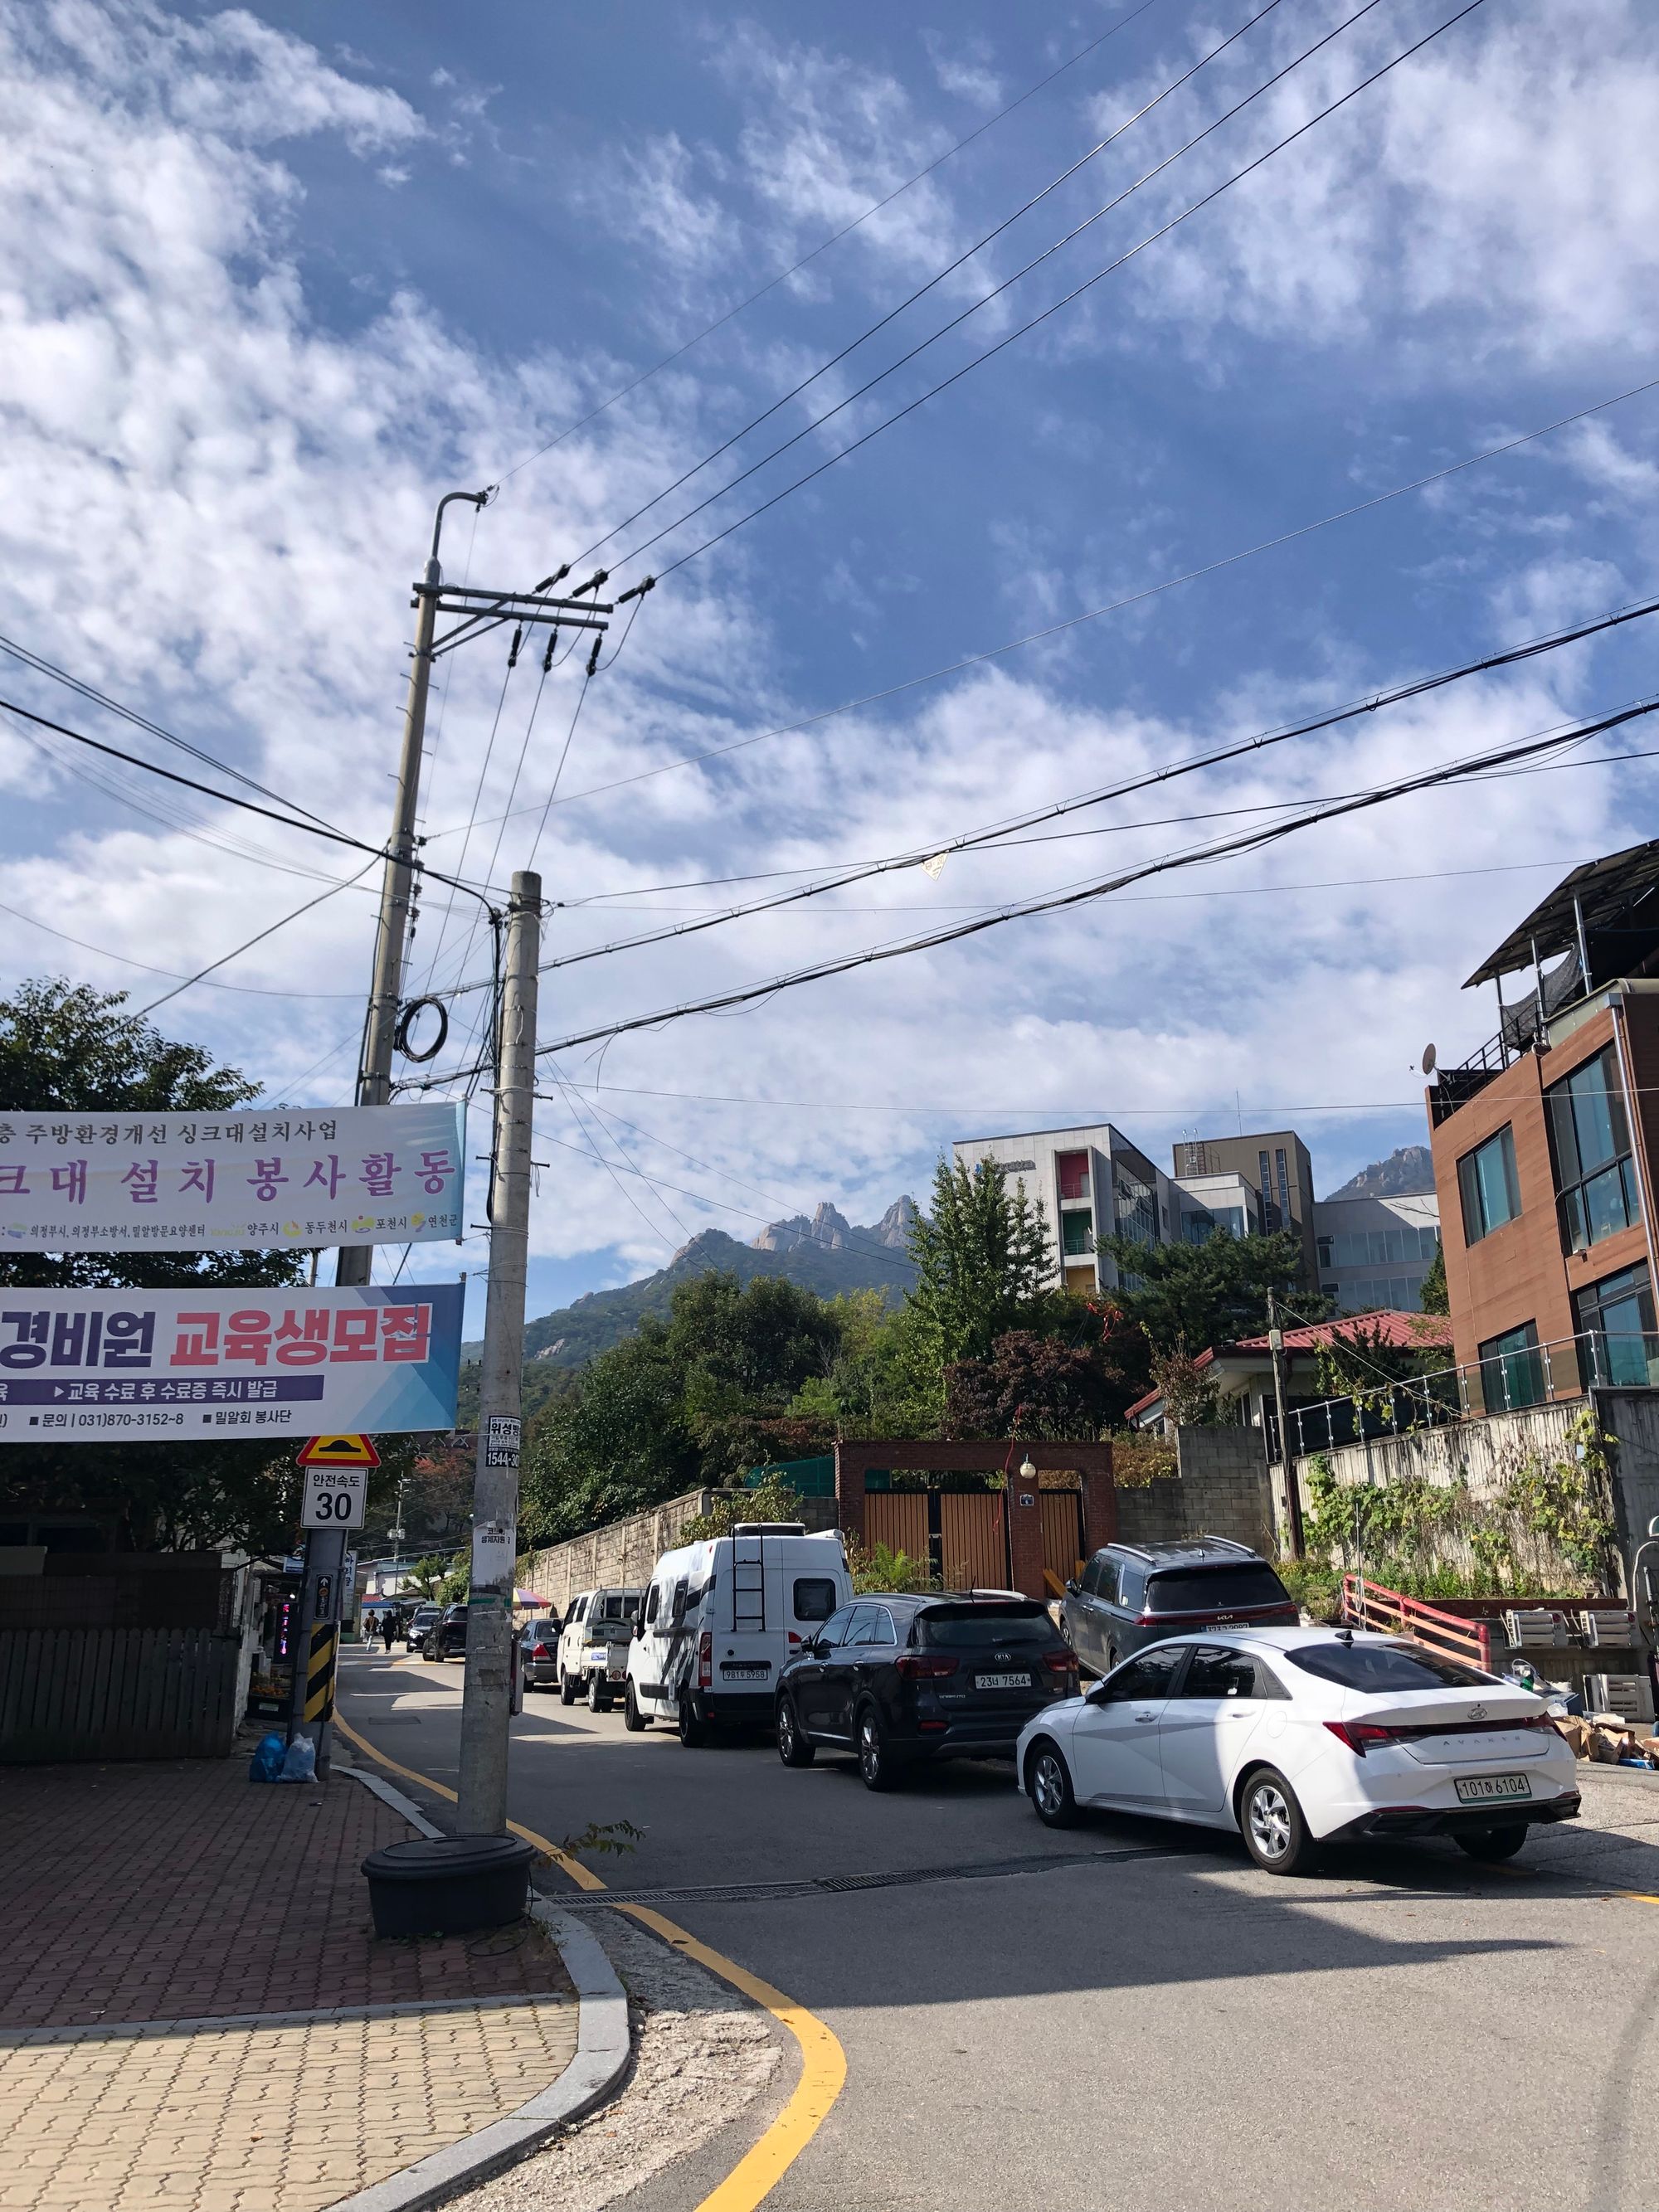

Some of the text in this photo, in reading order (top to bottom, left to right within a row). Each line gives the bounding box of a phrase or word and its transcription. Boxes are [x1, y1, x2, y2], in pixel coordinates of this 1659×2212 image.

[26, 1124, 167, 1145] 주방환경개선
[178, 1120, 337, 1144] 싱크대설치사업
[121, 1158, 215, 1204] 설치
[246, 1150, 455, 1203] 봉사활동
[247, 1222, 279, 1236] 양주시
[304, 1219, 348, 1234] 동두천시
[375, 1216, 406, 1230] 포천시
[428, 1213, 457, 1229] 연천군
[0, 1305, 429, 1369] 경비원 교육생모집
[68, 1383, 100, 1400] 교육
[105, 1383, 135, 1400] 수료
[140, 1382, 156, 1400] 후
[160, 1382, 207, 1400] 수료증
[212, 1381, 242, 1399] 즉시
[247, 1380, 278, 1398] 발급
[42, 1409, 292, 1427] 문의 031)870-3152~8 밀알회 봉사단
[313, 1474, 360, 1488] 안전속도
[315, 1492, 352, 1521] 30
[1002, 1675, 1027, 1686] 7564
[1496, 1777, 1525, 1794] 6104
